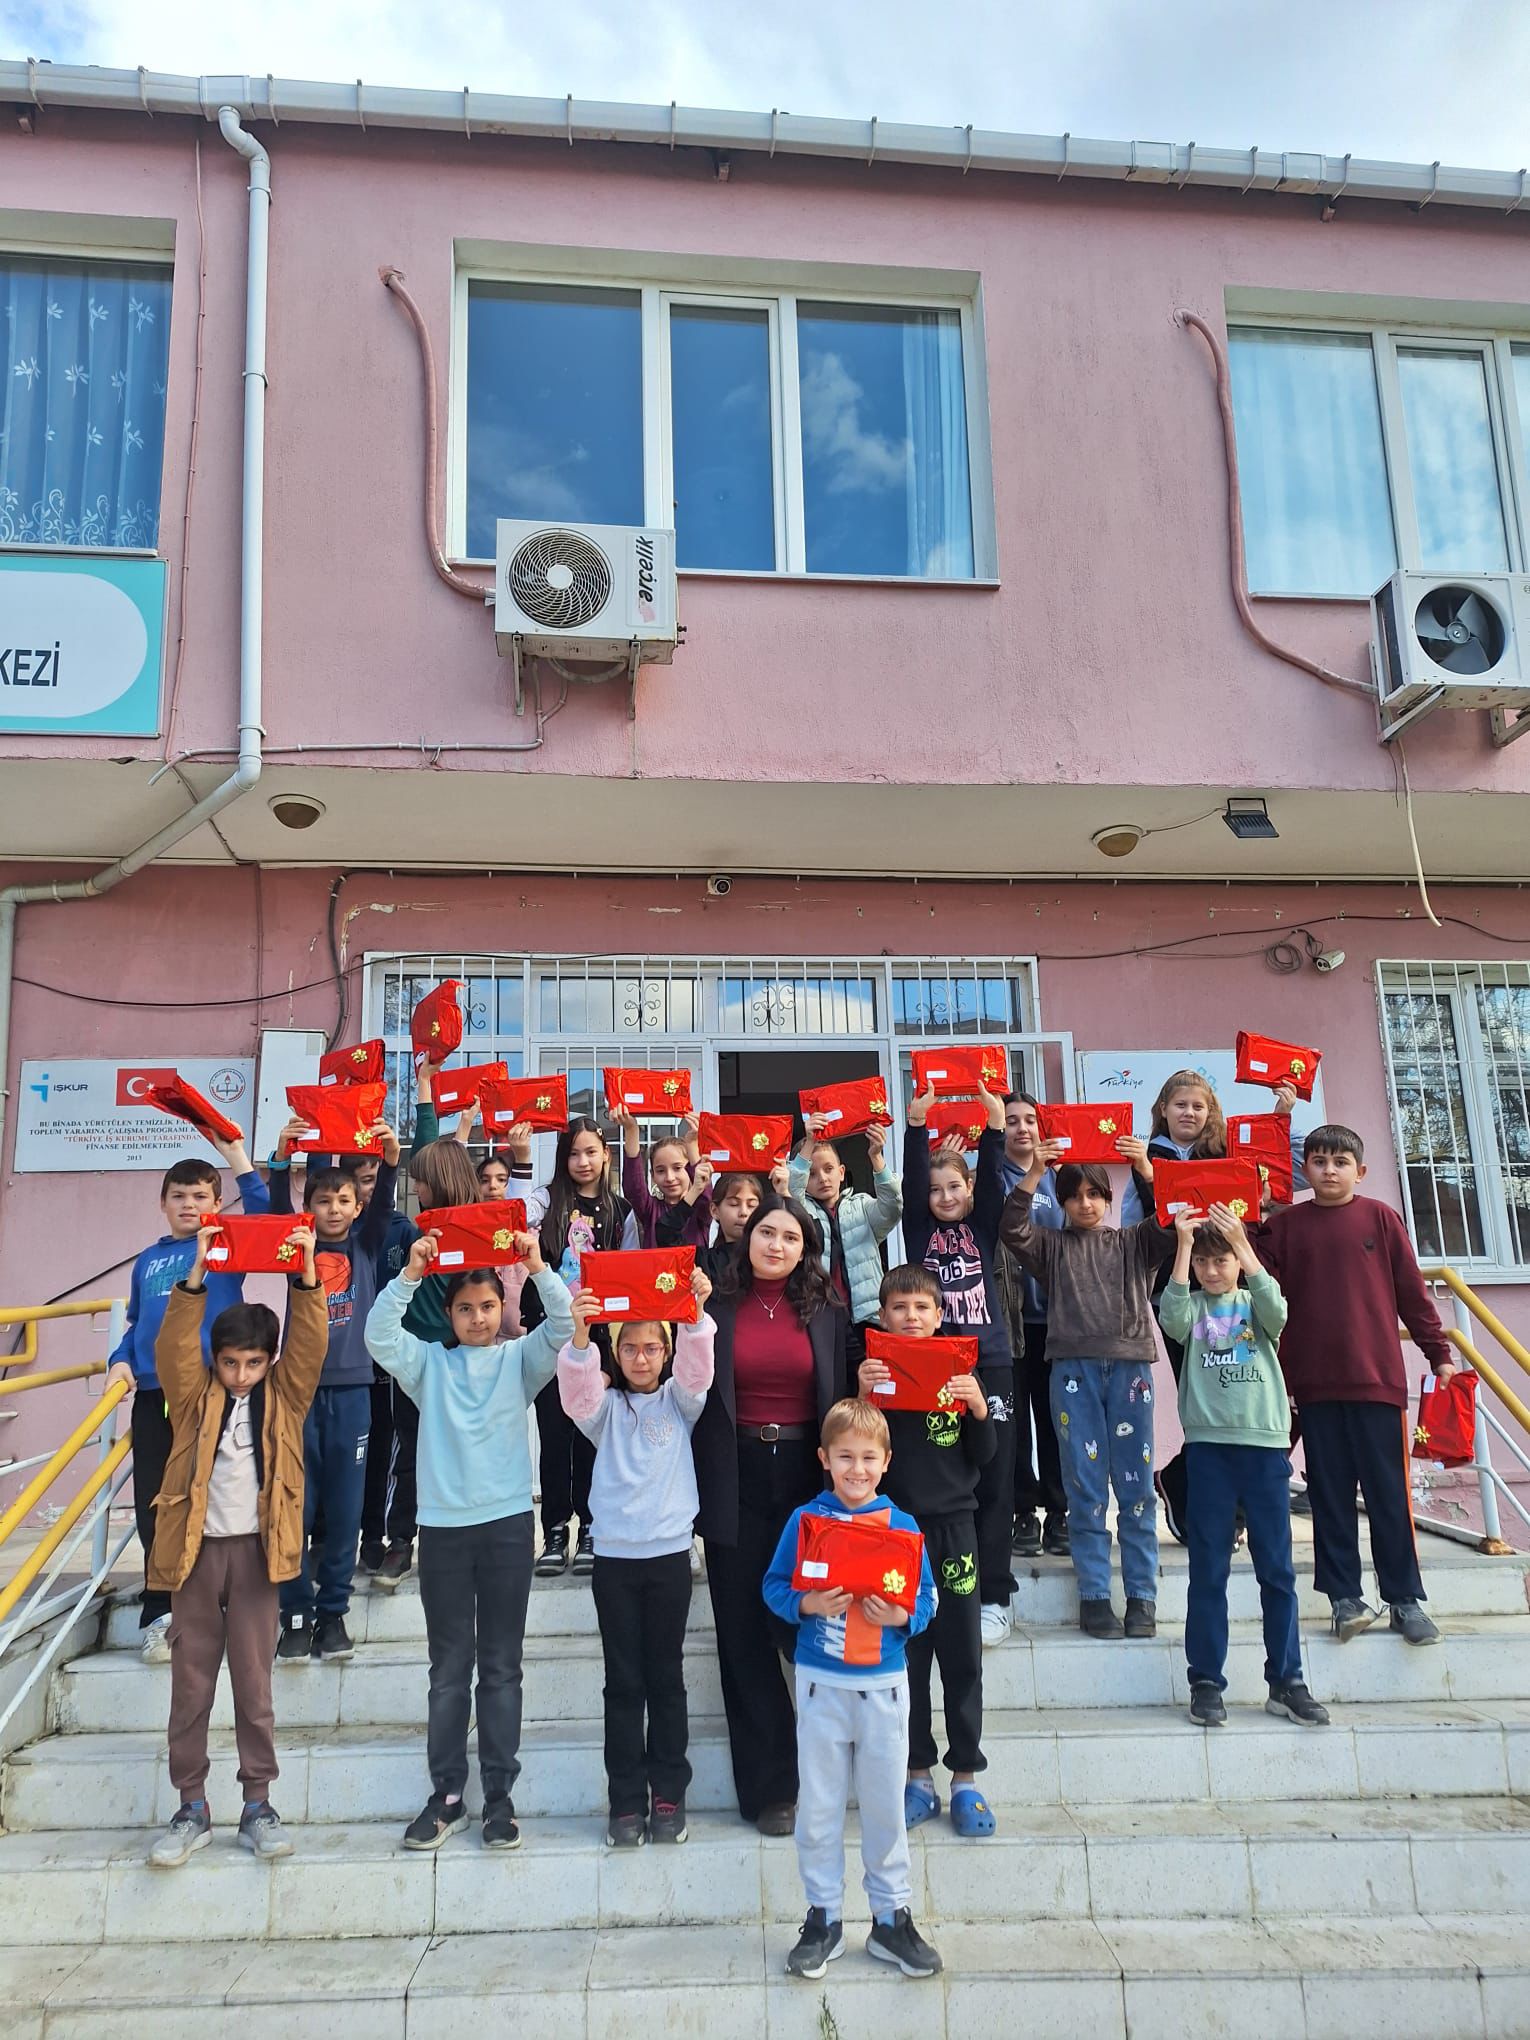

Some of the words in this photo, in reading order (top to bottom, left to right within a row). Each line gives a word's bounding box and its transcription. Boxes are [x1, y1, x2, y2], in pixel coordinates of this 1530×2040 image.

[636, 535, 658, 603] arçelik
[53, 1083, 89, 1093] İŞKUR
[1098, 1075, 1144, 1089] Türkiye
[84, 1118, 132, 1127] YÜRÜTÜLEN
[135, 1118, 173, 1126] TEMİZLİK
[108, 1127, 144, 1135] ÇALIŞMA
[105, 1135, 113, 1143] İŞ
[1202, 1349, 1240, 1368] Kral
[1219, 1366, 1267, 1388] Şakir
